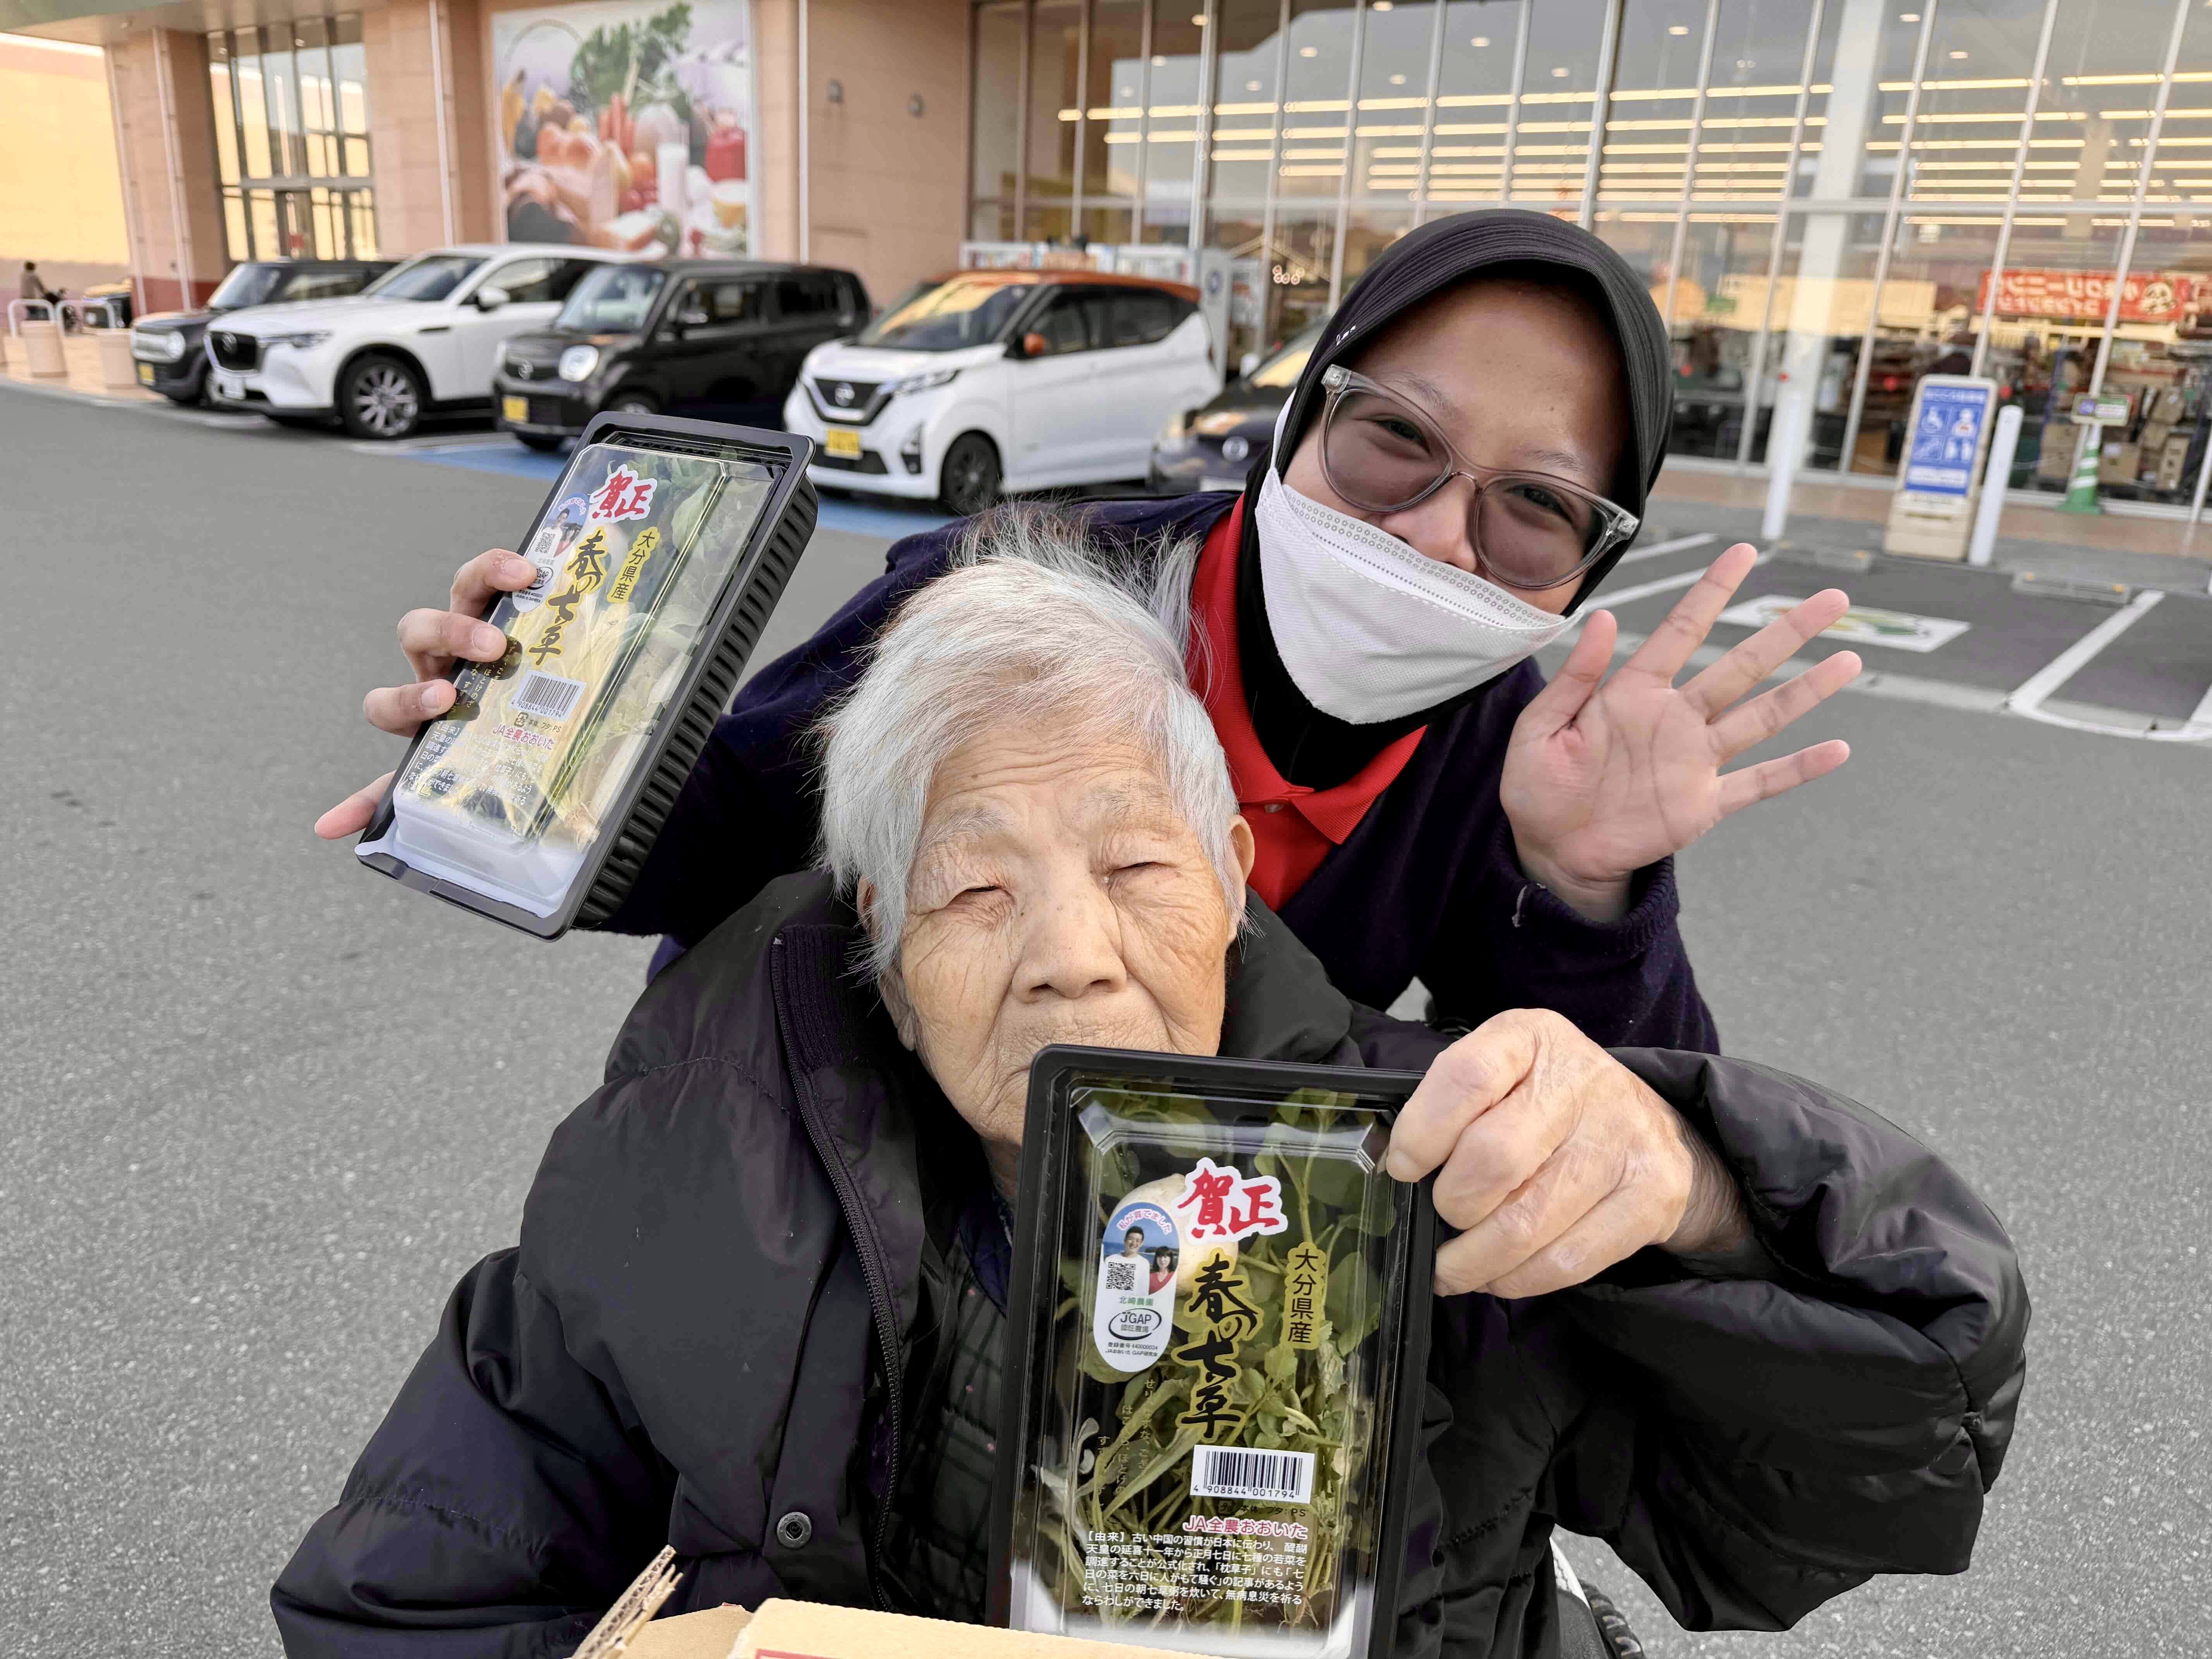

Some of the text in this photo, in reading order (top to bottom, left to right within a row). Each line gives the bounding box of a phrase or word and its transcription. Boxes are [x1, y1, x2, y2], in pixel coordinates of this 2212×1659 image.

[592, 471, 651, 519] 賀正
[612, 532, 655, 599] 大分県産
[529, 530, 605, 665] 春の七草
[519, 701, 538, 711] 908844
[541, 707, 562, 717] 001794
[493, 724, 555, 750] JA全農おおいた
[1178, 1168, 1279, 1238] 賀正
[1117, 1209, 1172, 1234] 私が育てました
[1288, 1249, 1319, 1344] 大分県産
[1120, 1313, 1152, 1324] JGAP
[1177, 1253, 1259, 1438] 春の七草
[1207, 1486, 1246, 1495] 908844
[1253, 1488, 1295, 1499] 001794
[1183, 1516, 1307, 1539] JA全農おおいた
[1086, 1543, 1306, 1566] 天皇の延喜十一年から正月七日に七種の若菜を
[1082, 1595, 1184, 1611] ならわしができました。
